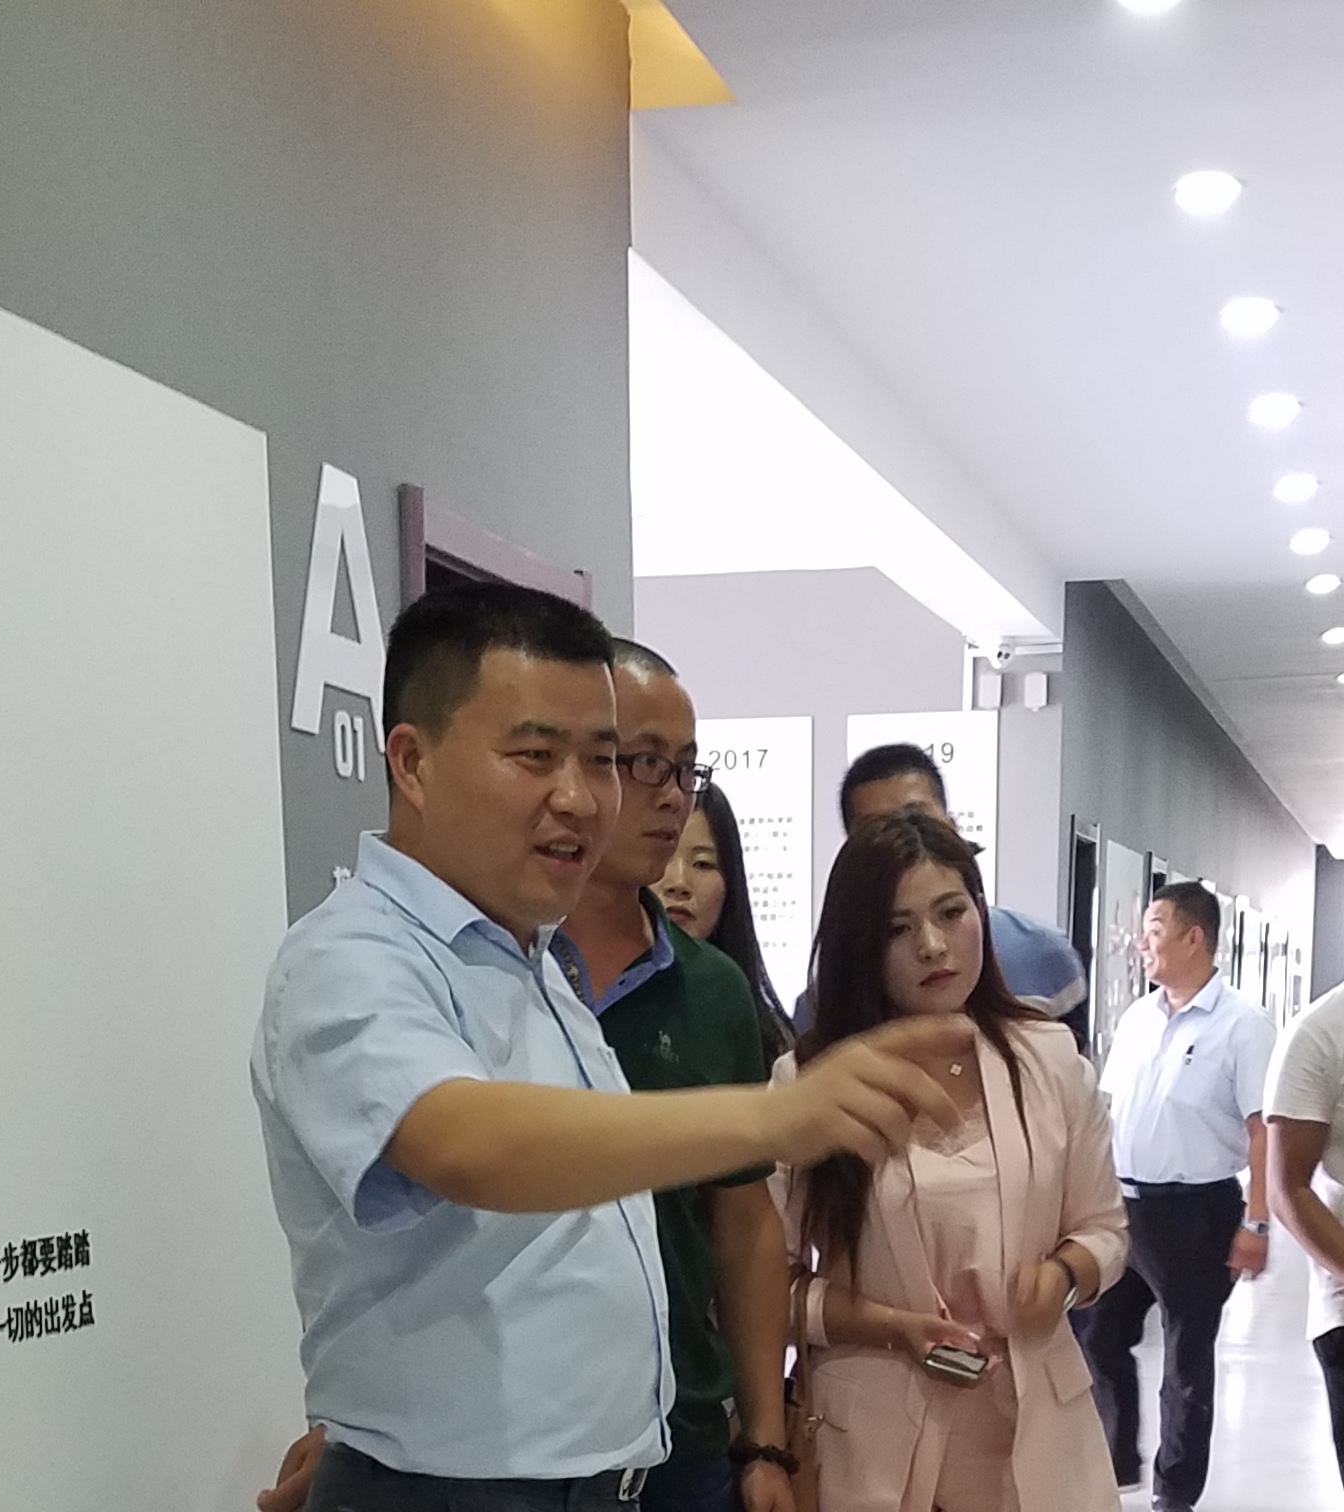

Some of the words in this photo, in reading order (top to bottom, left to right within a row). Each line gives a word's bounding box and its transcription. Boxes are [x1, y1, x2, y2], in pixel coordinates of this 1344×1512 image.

[291, 462, 386, 754] A
[334, 711, 366, 782] 01
[709, 749, 769, 771] 2017
